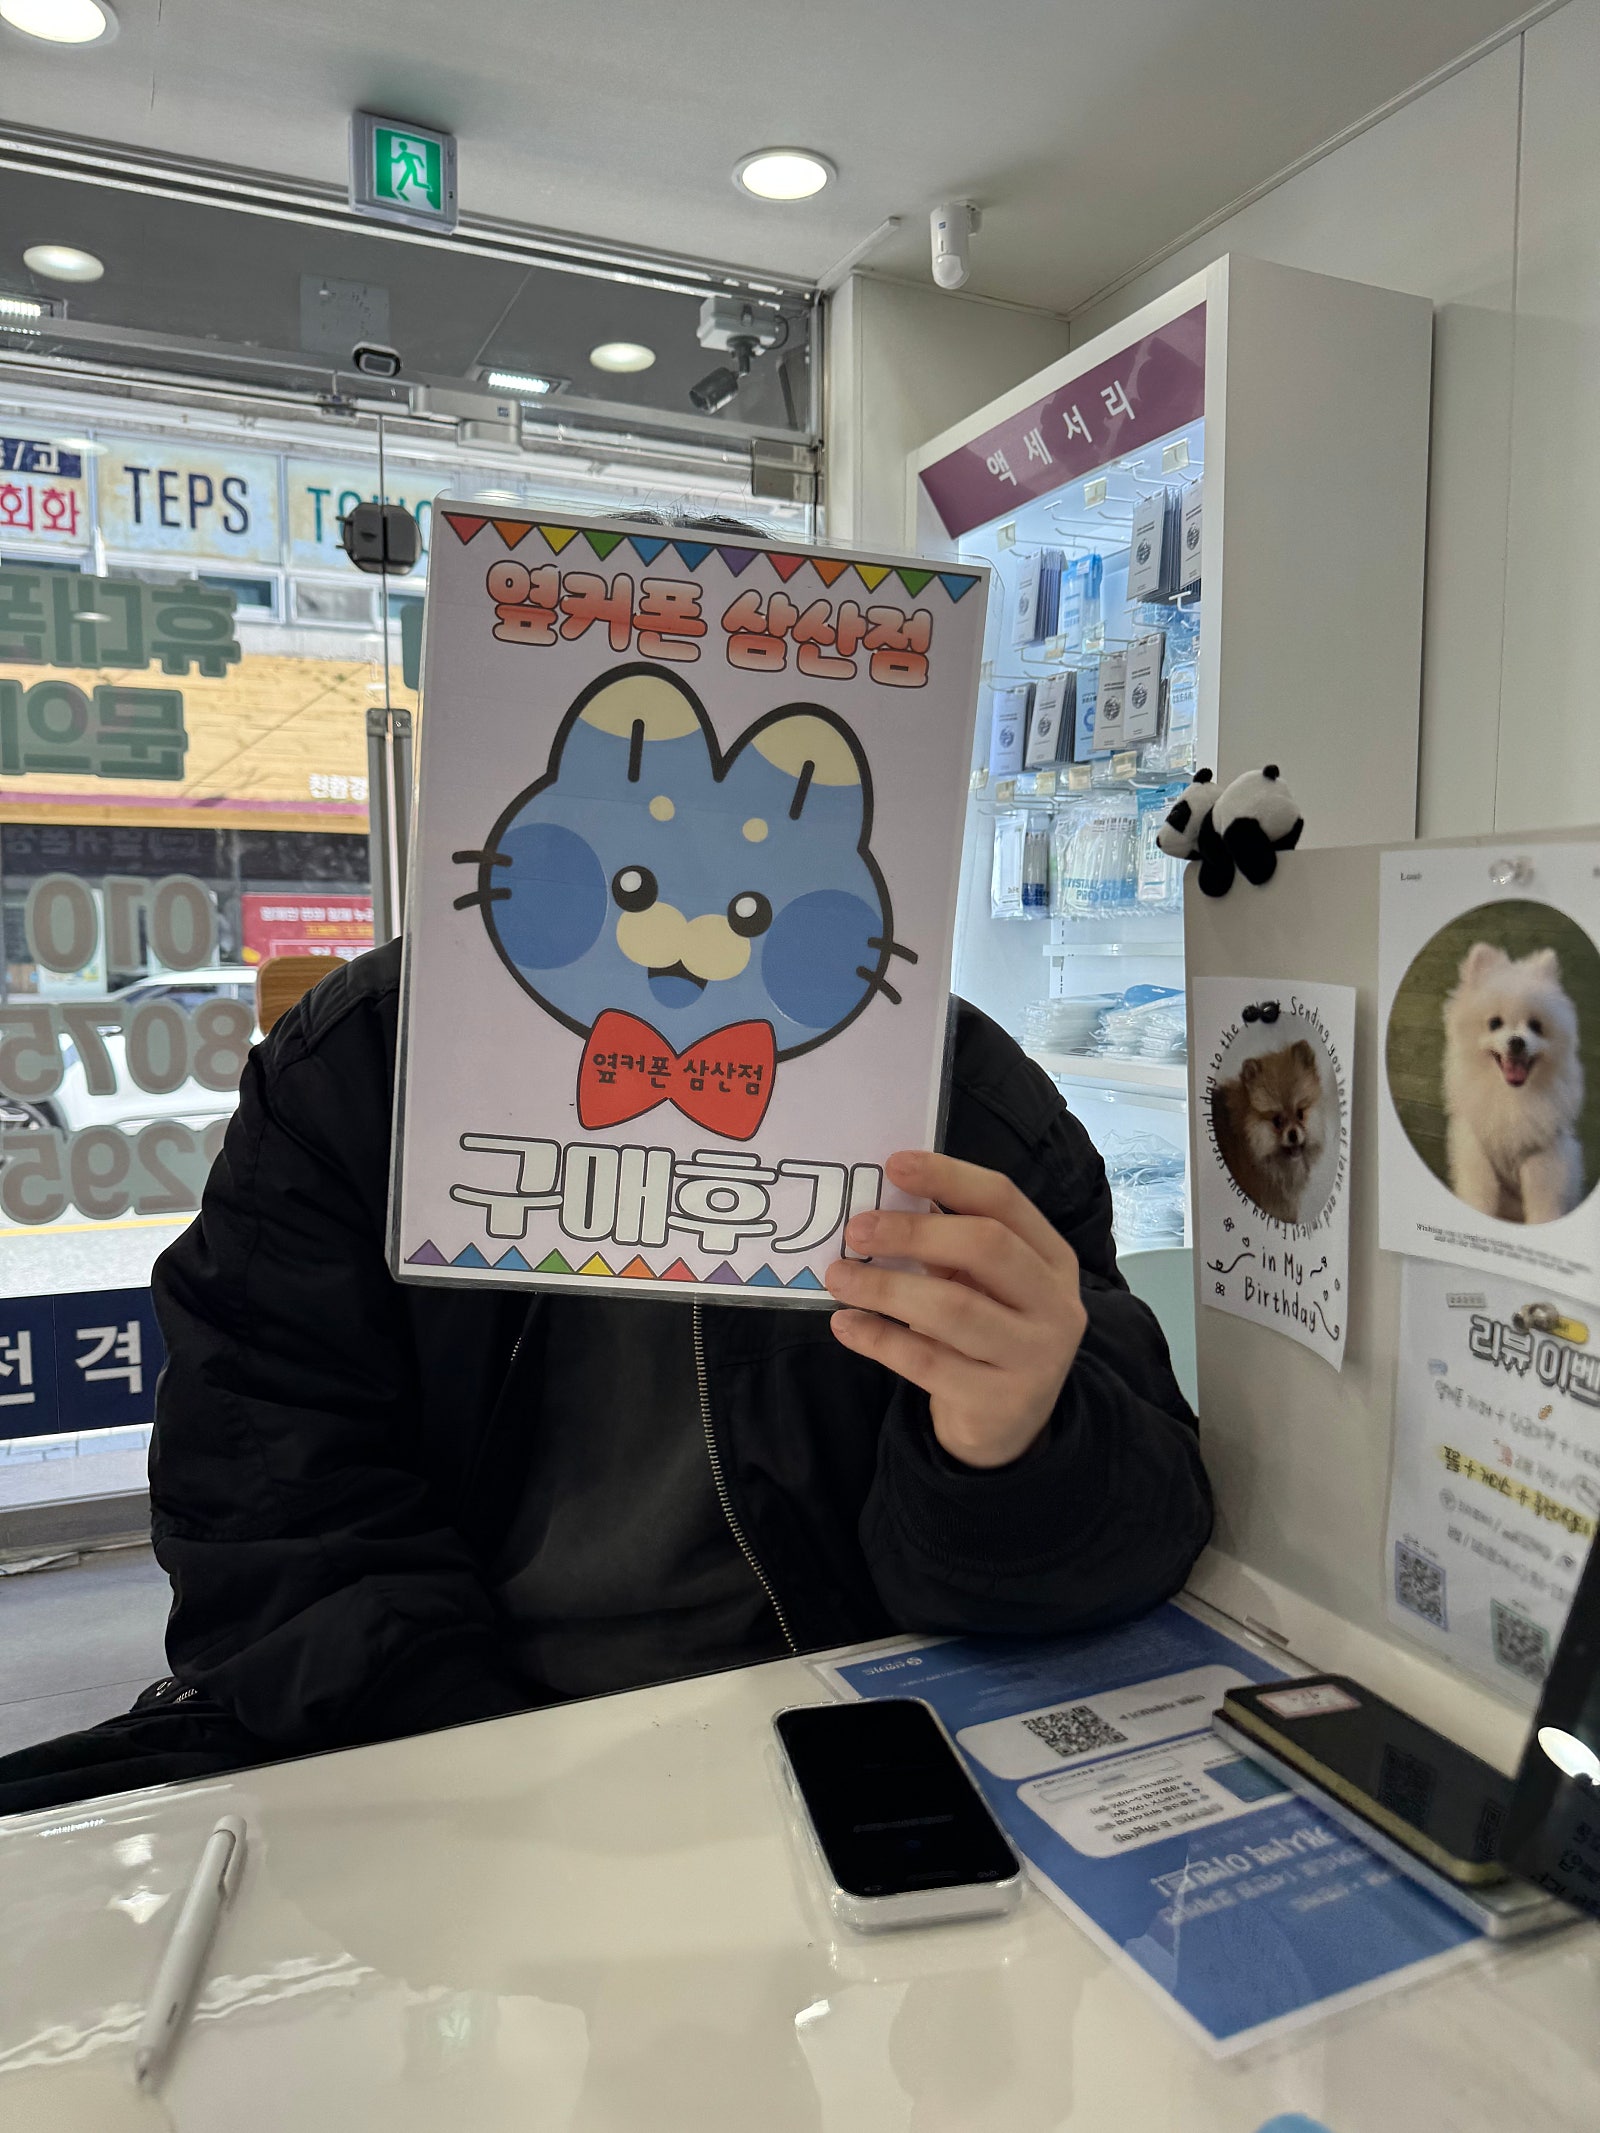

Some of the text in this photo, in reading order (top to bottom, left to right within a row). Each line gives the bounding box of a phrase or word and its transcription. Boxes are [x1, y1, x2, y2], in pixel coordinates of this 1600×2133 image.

[986, 379, 1136, 487] 액세서리
[0, 484, 80, 536] 회화
[123, 466, 250, 535] TEPS
[486, 560, 934, 688] 옆커폰 삼산점
[1220, 1023, 1240, 1049] the
[1290, 996, 1330, 1043] Sending
[592, 1051, 764, 1096] 옆커폰 삼산점
[1210, 1053, 1223, 1070] to
[449, 1131, 883, 1264] 구매후기
[1262, 1246, 1303, 1285] in My
[1245, 1275, 1317, 1333] Birthday
[1469, 1314, 1533, 1378] 리뷰
